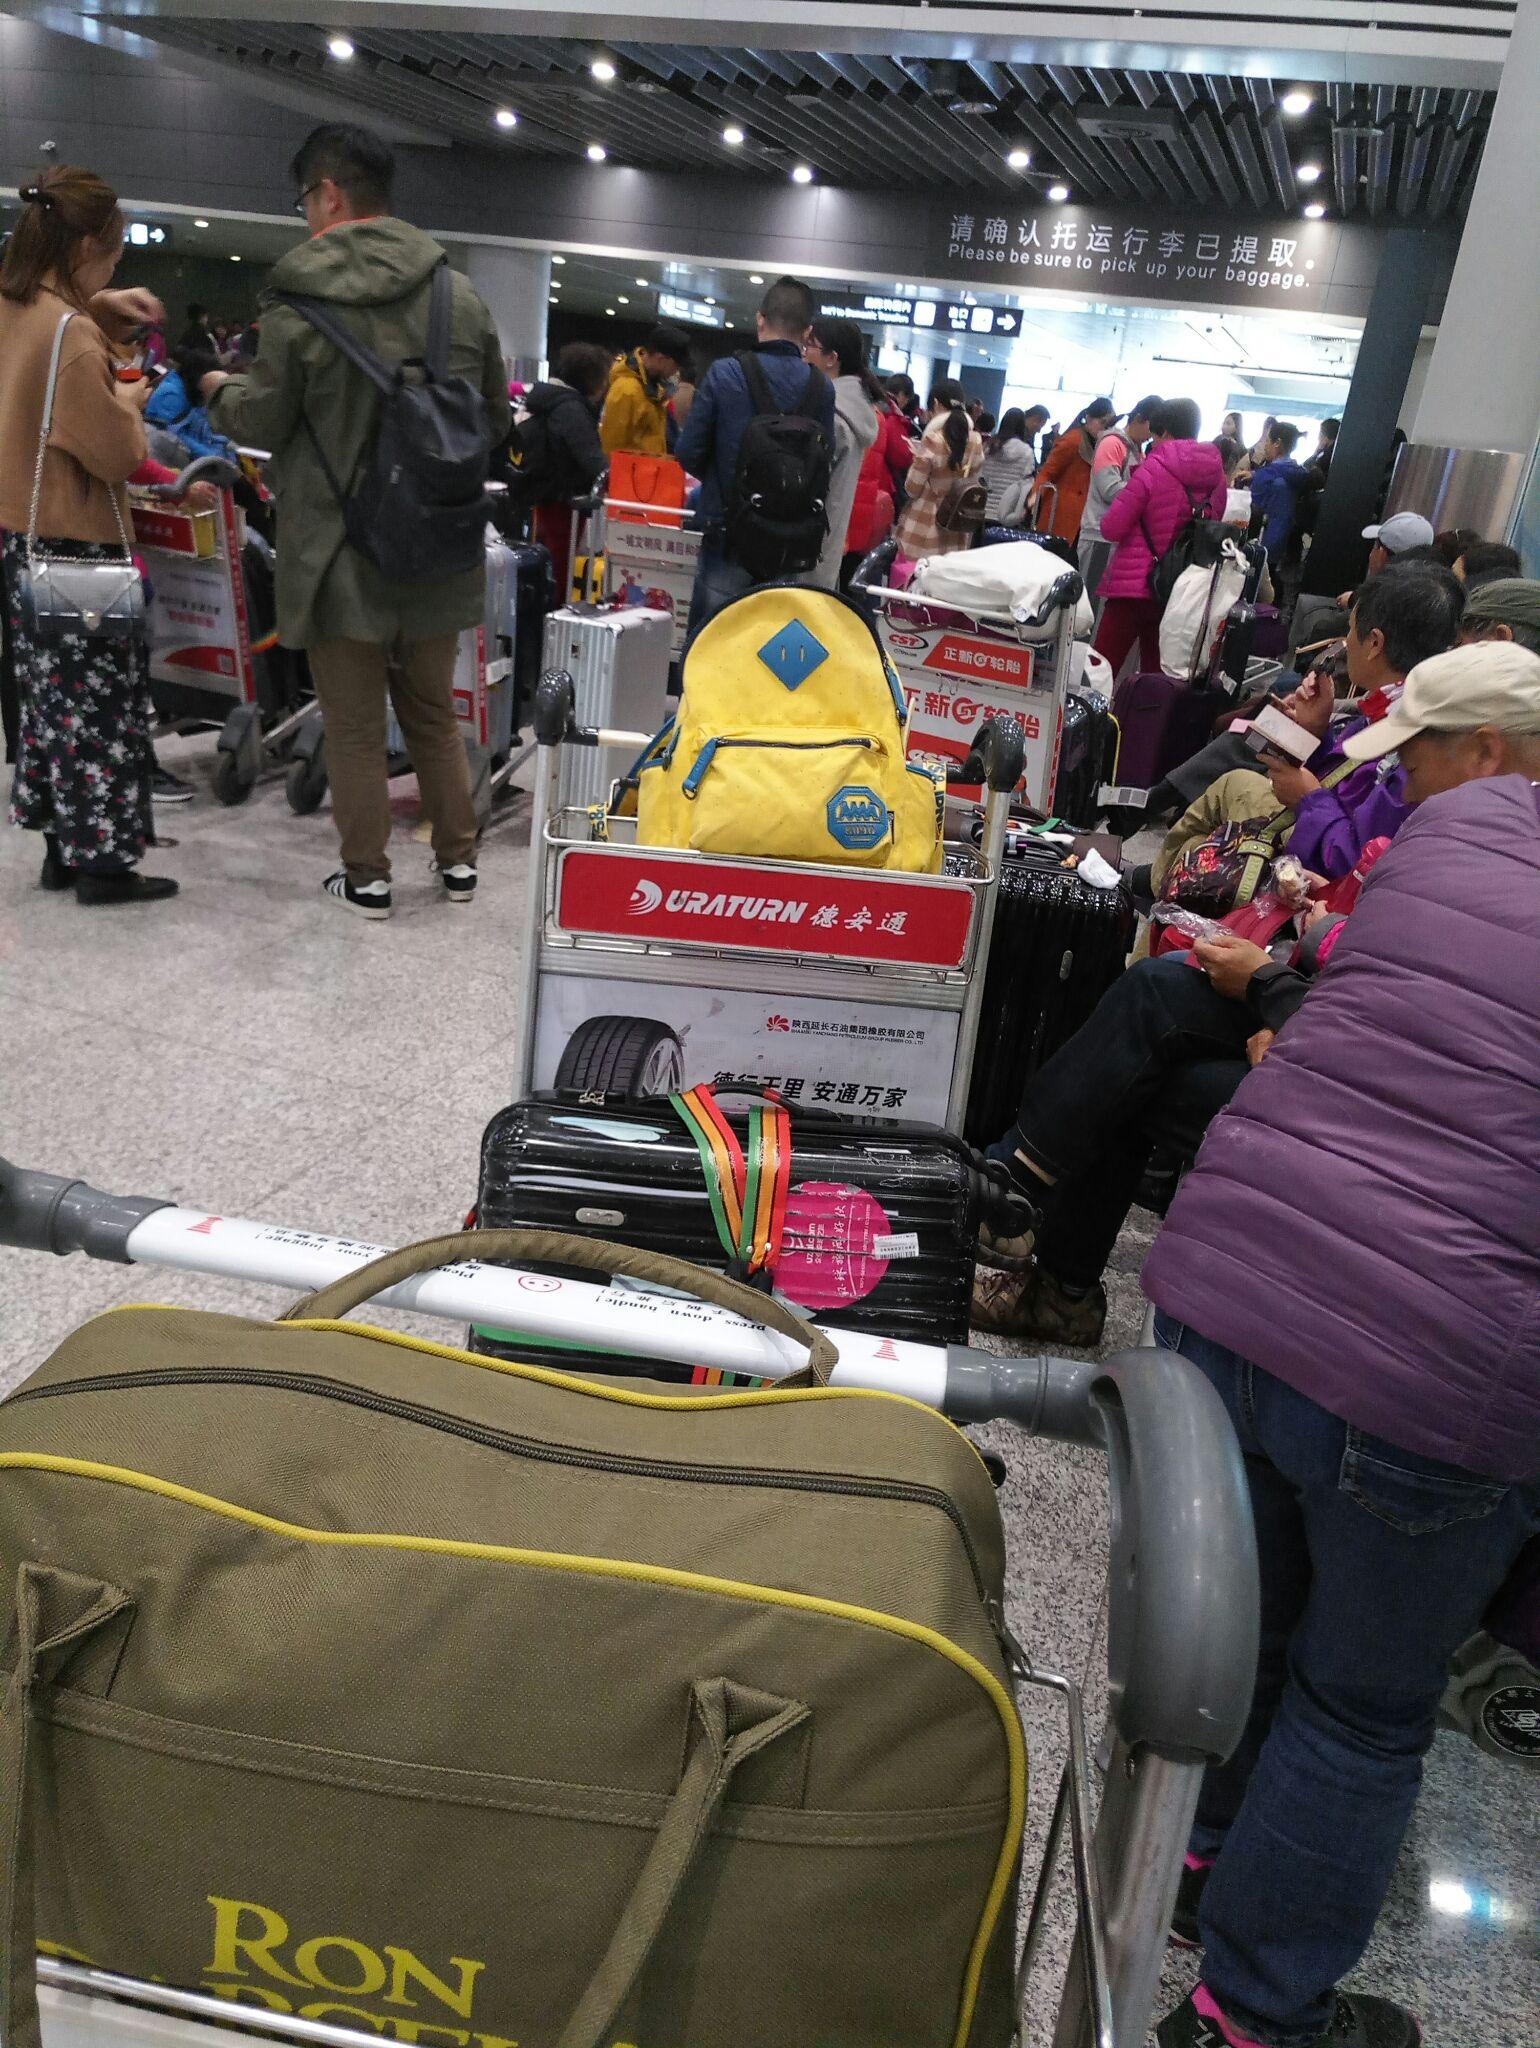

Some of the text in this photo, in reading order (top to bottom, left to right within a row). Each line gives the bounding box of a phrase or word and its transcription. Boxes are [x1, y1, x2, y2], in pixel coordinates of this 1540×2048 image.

[948, 243, 1311, 289] Please be sure to pick up your baggage.
[888, 633, 919, 647] CST
[810, 904, 909, 936] 德安通
[791, 1018, 926, 1041] 陕西延长石油集团橡胶有限公司
[811, 1080, 908, 1108] 安通万家
[203, 1895, 486, 2018] RON
